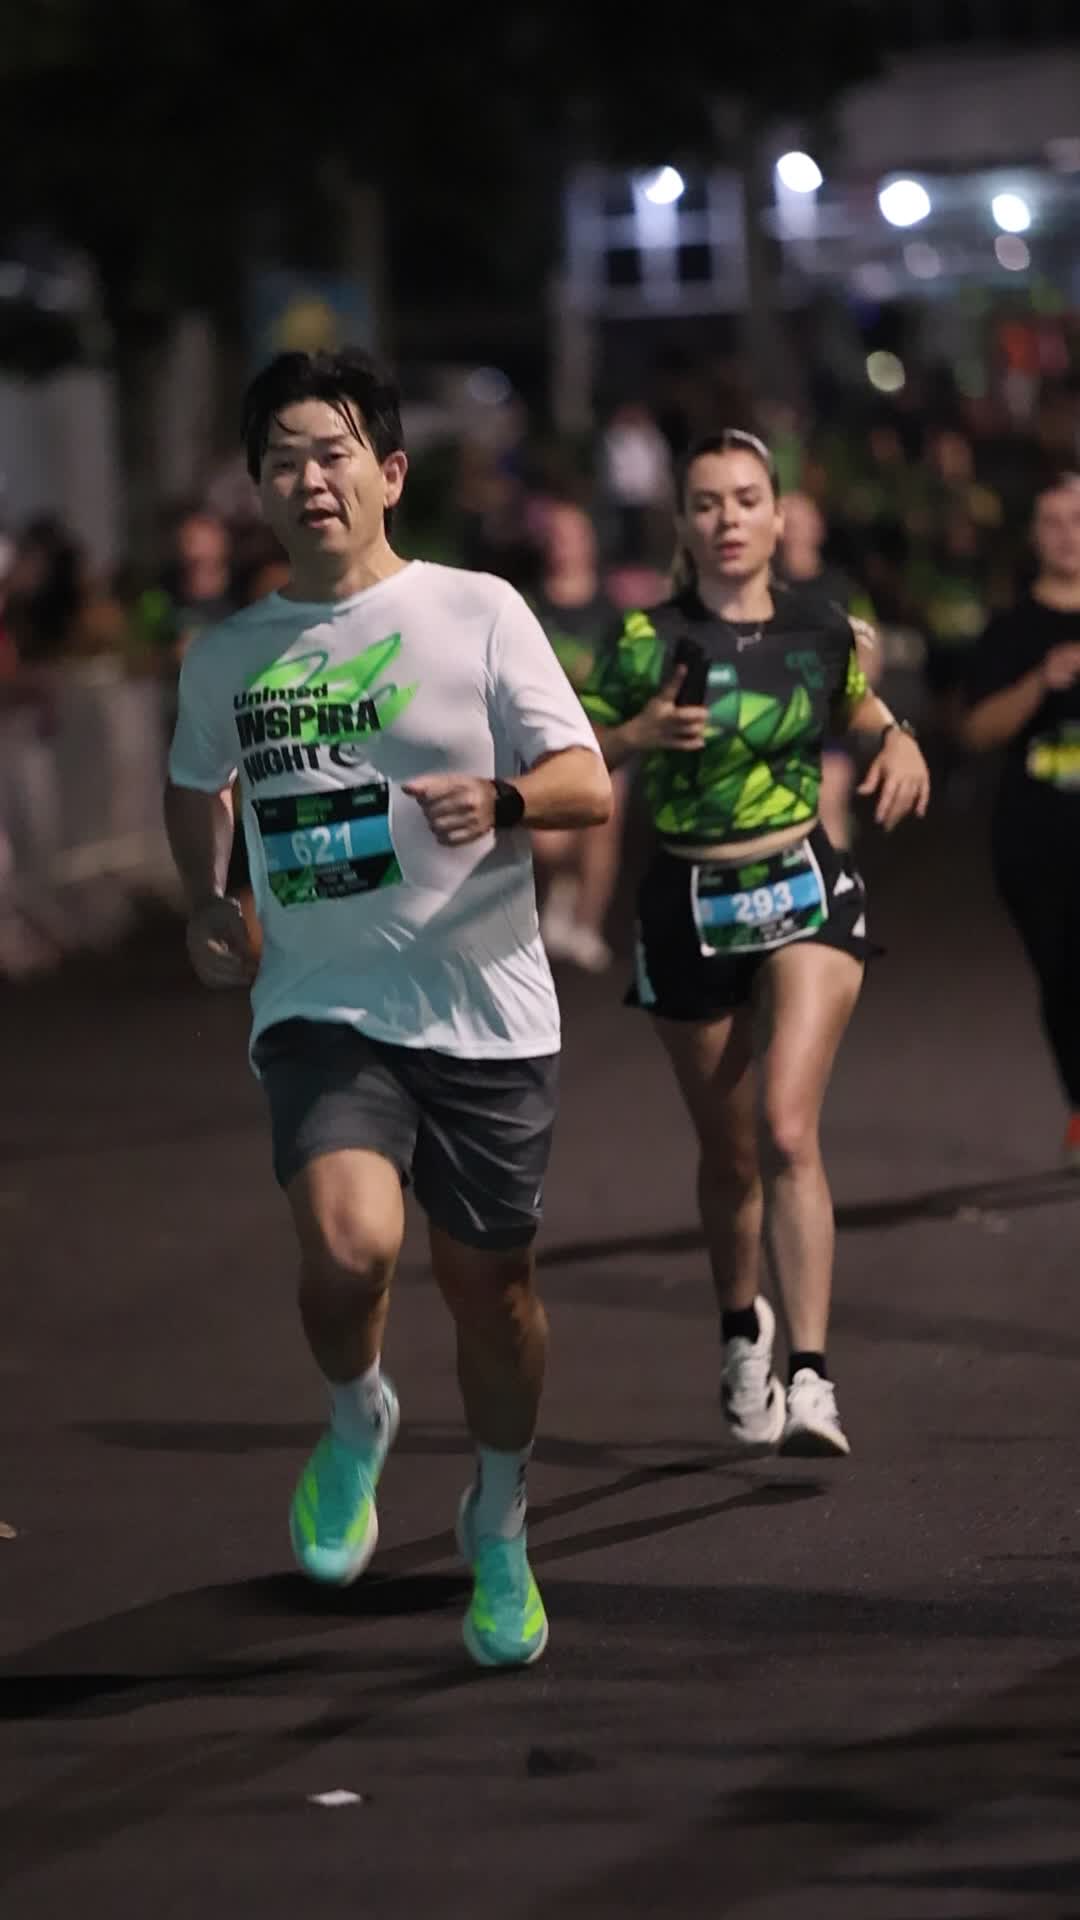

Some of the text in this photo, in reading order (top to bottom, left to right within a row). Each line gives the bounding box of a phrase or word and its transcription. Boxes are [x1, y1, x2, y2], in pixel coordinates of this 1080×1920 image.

[233, 682, 328, 710] Unimed
[234, 698, 381, 750] INSPIRA
[243, 743, 320, 785] NIGHT
[291, 820, 354, 866] 621
[731, 881, 794, 921] 293
